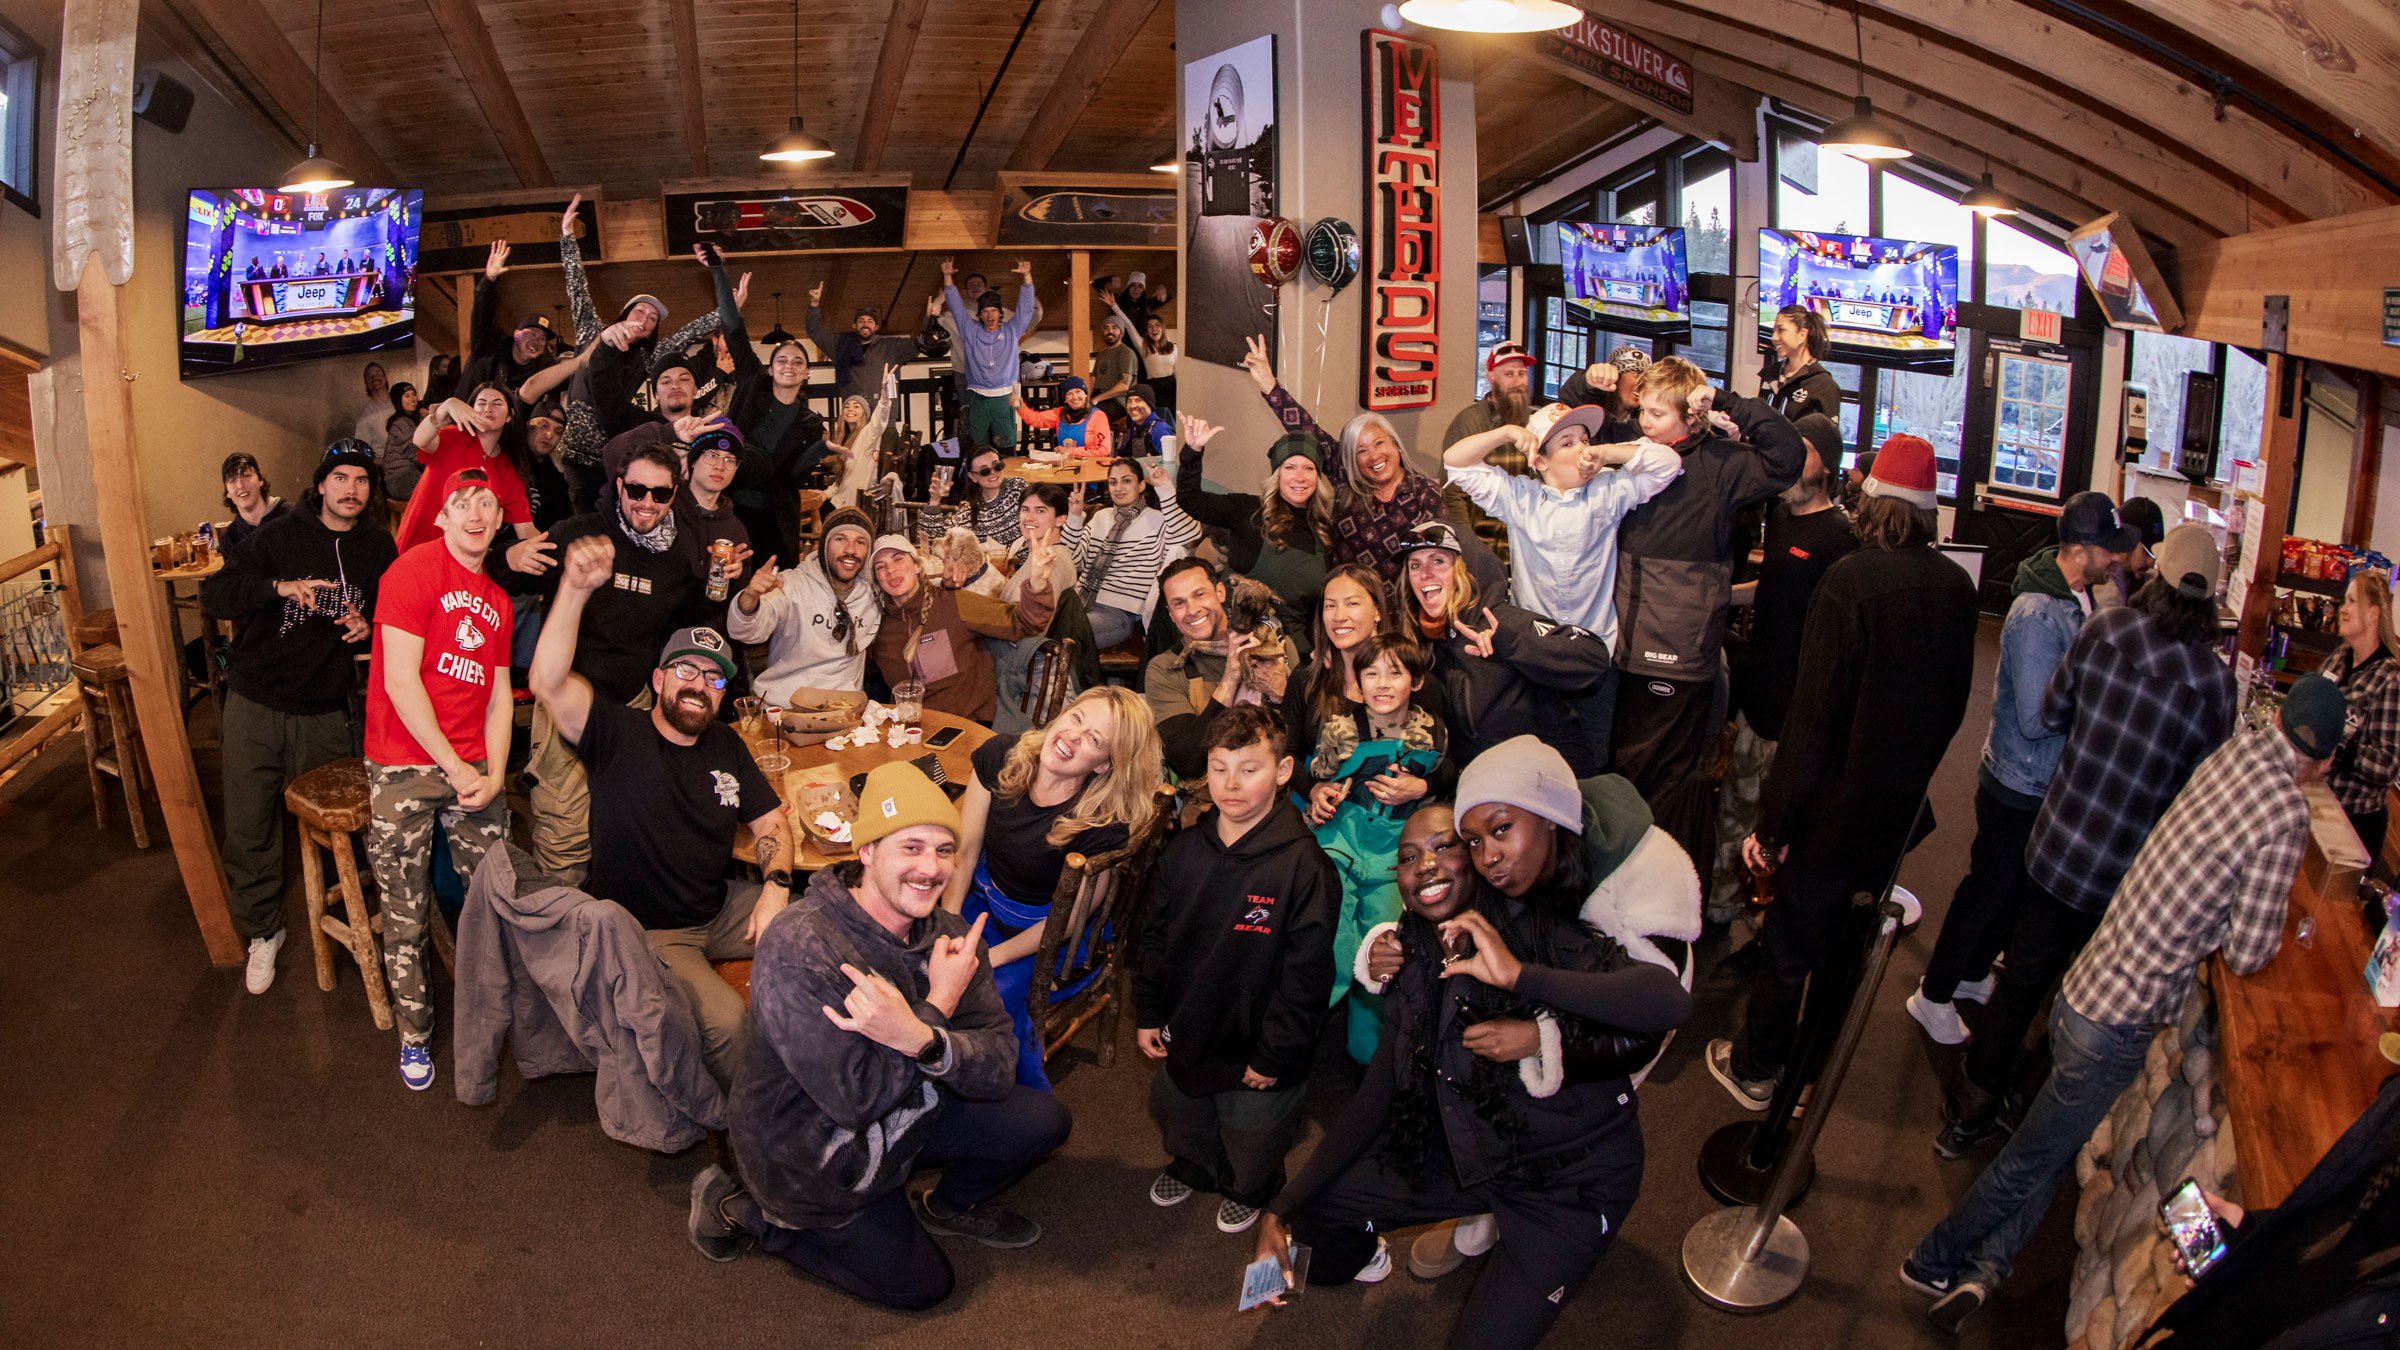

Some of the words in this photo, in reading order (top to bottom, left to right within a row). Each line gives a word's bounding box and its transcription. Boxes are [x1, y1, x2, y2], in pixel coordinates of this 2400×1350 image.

[1552, 20, 1663, 80] UIKSILVER
[1609, 65, 1692, 111] SPONSOR
[345, 197, 360, 210] 24
[307, 211, 324, 222] FOX
[1379, 40, 1442, 382] METHODS
[1885, 247, 1899, 258] 24
[297, 285, 326, 301] Jeep
[1617, 284, 1632, 294] Jeep
[1849, 305, 1873, 319] Jeep
[2028, 311, 2056, 338] EXIT
[1376, 384, 1411, 398] SPORTS
[1411, 384, 1429, 396] BAR
[481, 602, 501, 632] CITY
[1644, 651, 1658, 659] BIG
[1658, 653, 1679, 662] BEAR
[1247, 894, 1275, 905] TEAM
[1232, 923, 1272, 935] BEAR
